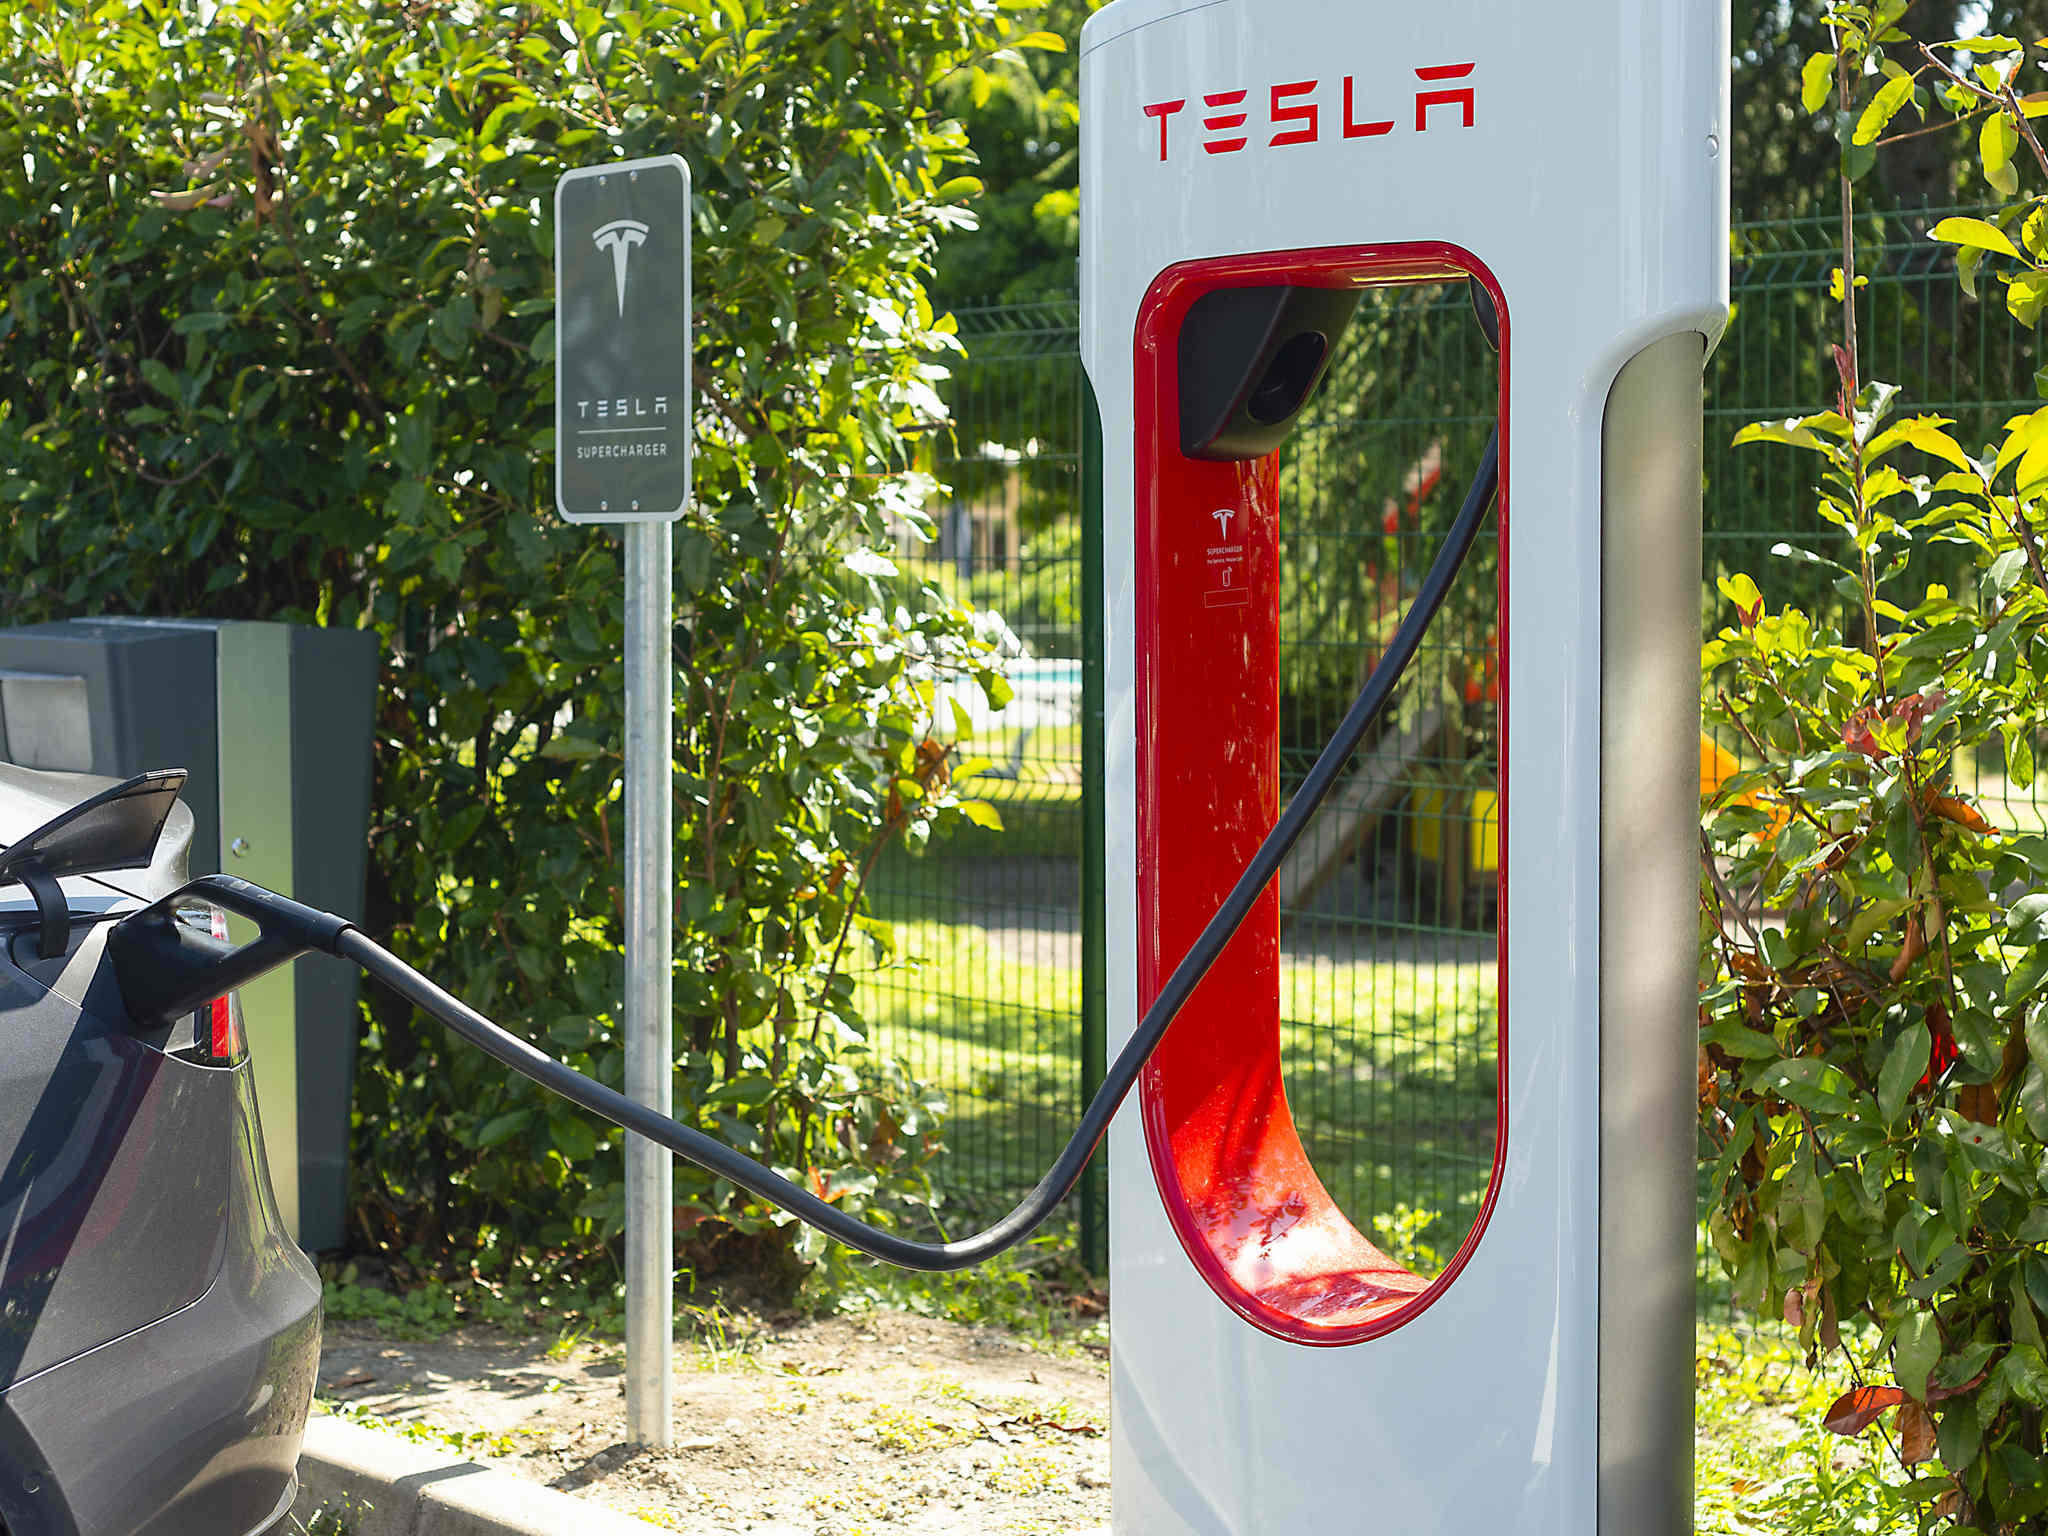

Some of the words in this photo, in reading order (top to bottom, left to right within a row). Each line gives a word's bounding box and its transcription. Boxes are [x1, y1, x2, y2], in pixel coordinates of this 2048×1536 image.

[1143, 62, 1475, 162] TESLA
[577, 396, 667, 418] TESLA
[577, 442, 667, 459] SUPERCHARGER
